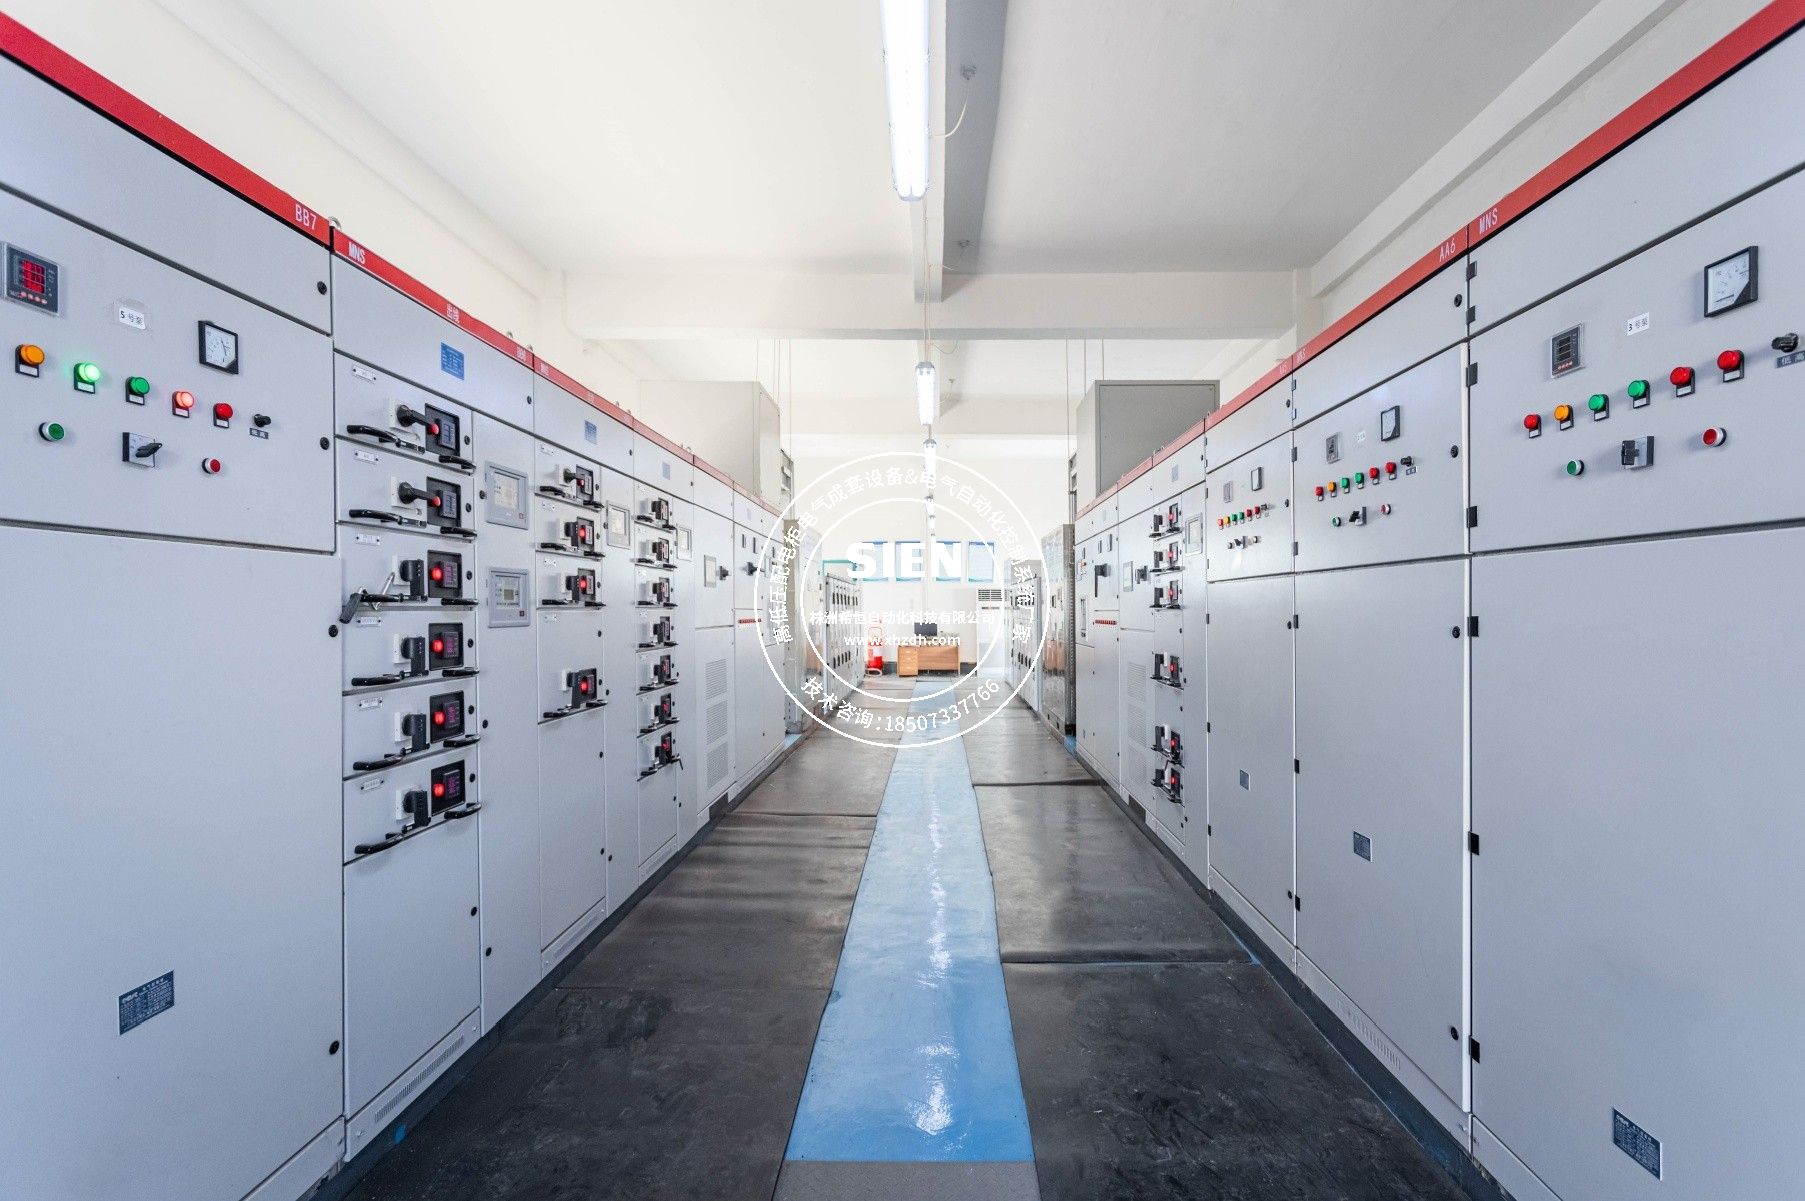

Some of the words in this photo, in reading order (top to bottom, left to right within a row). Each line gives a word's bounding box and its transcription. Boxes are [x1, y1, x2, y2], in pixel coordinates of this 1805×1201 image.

[295, 203, 317, 231] BB7
[1479, 207, 1498, 235] MNS
[348, 241, 366, 265] MNS
[1439, 238, 1456, 262] AA6
